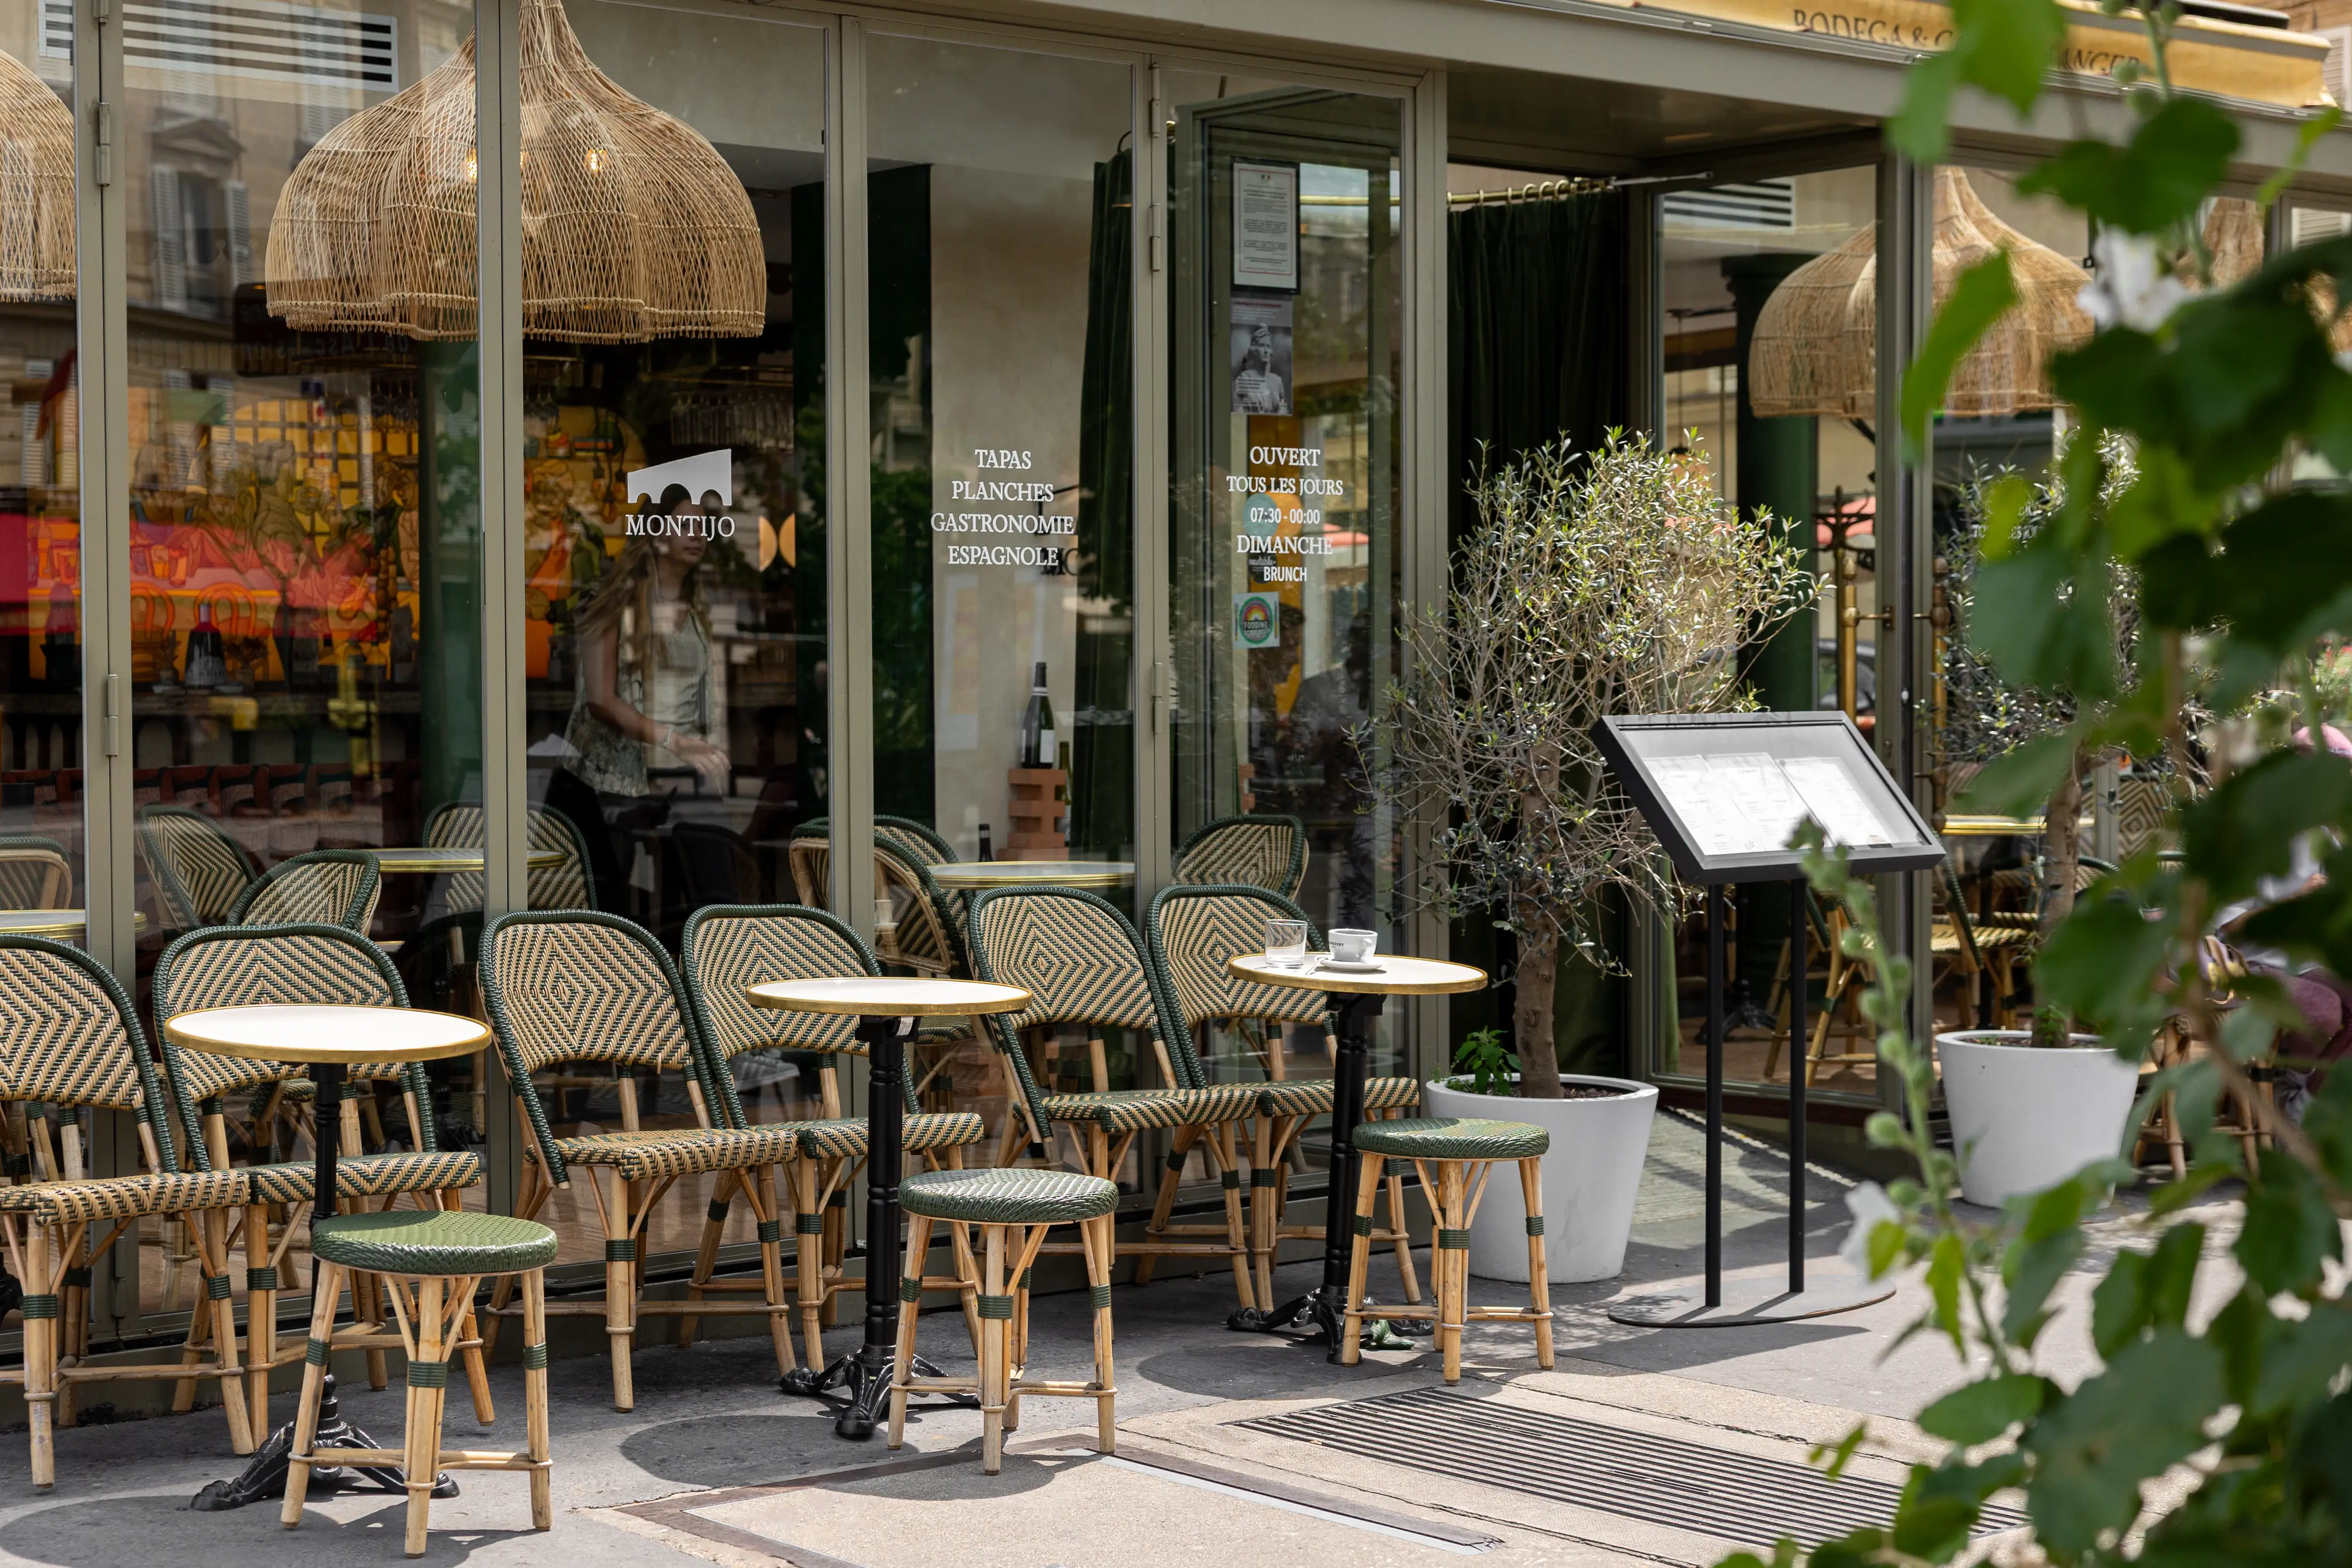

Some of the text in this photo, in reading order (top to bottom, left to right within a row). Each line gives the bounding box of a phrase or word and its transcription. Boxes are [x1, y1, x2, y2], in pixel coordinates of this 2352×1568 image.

[1794, 9, 1906, 48] BODEGA
[1912, 25, 1928, 47] &
[974, 449, 1032, 470] TAPAS
[1249, 446, 1321, 466] OUVERT
[951, 481, 1054, 502] PLANCHES
[1226, 475, 1344, 496] TOUS LES JOURS
[931, 512, 1074, 535] GASTRONOMIE
[1250, 508, 1281, 524] 07:30
[1289, 509, 1321, 524] 00:00
[625, 514, 736, 541] MONTIJO
[947, 545, 1058, 566] ESPAGNOLE
[1236, 535, 1333, 555] DIMANCHE
[1263, 566, 1307, 582] BRUNCH
